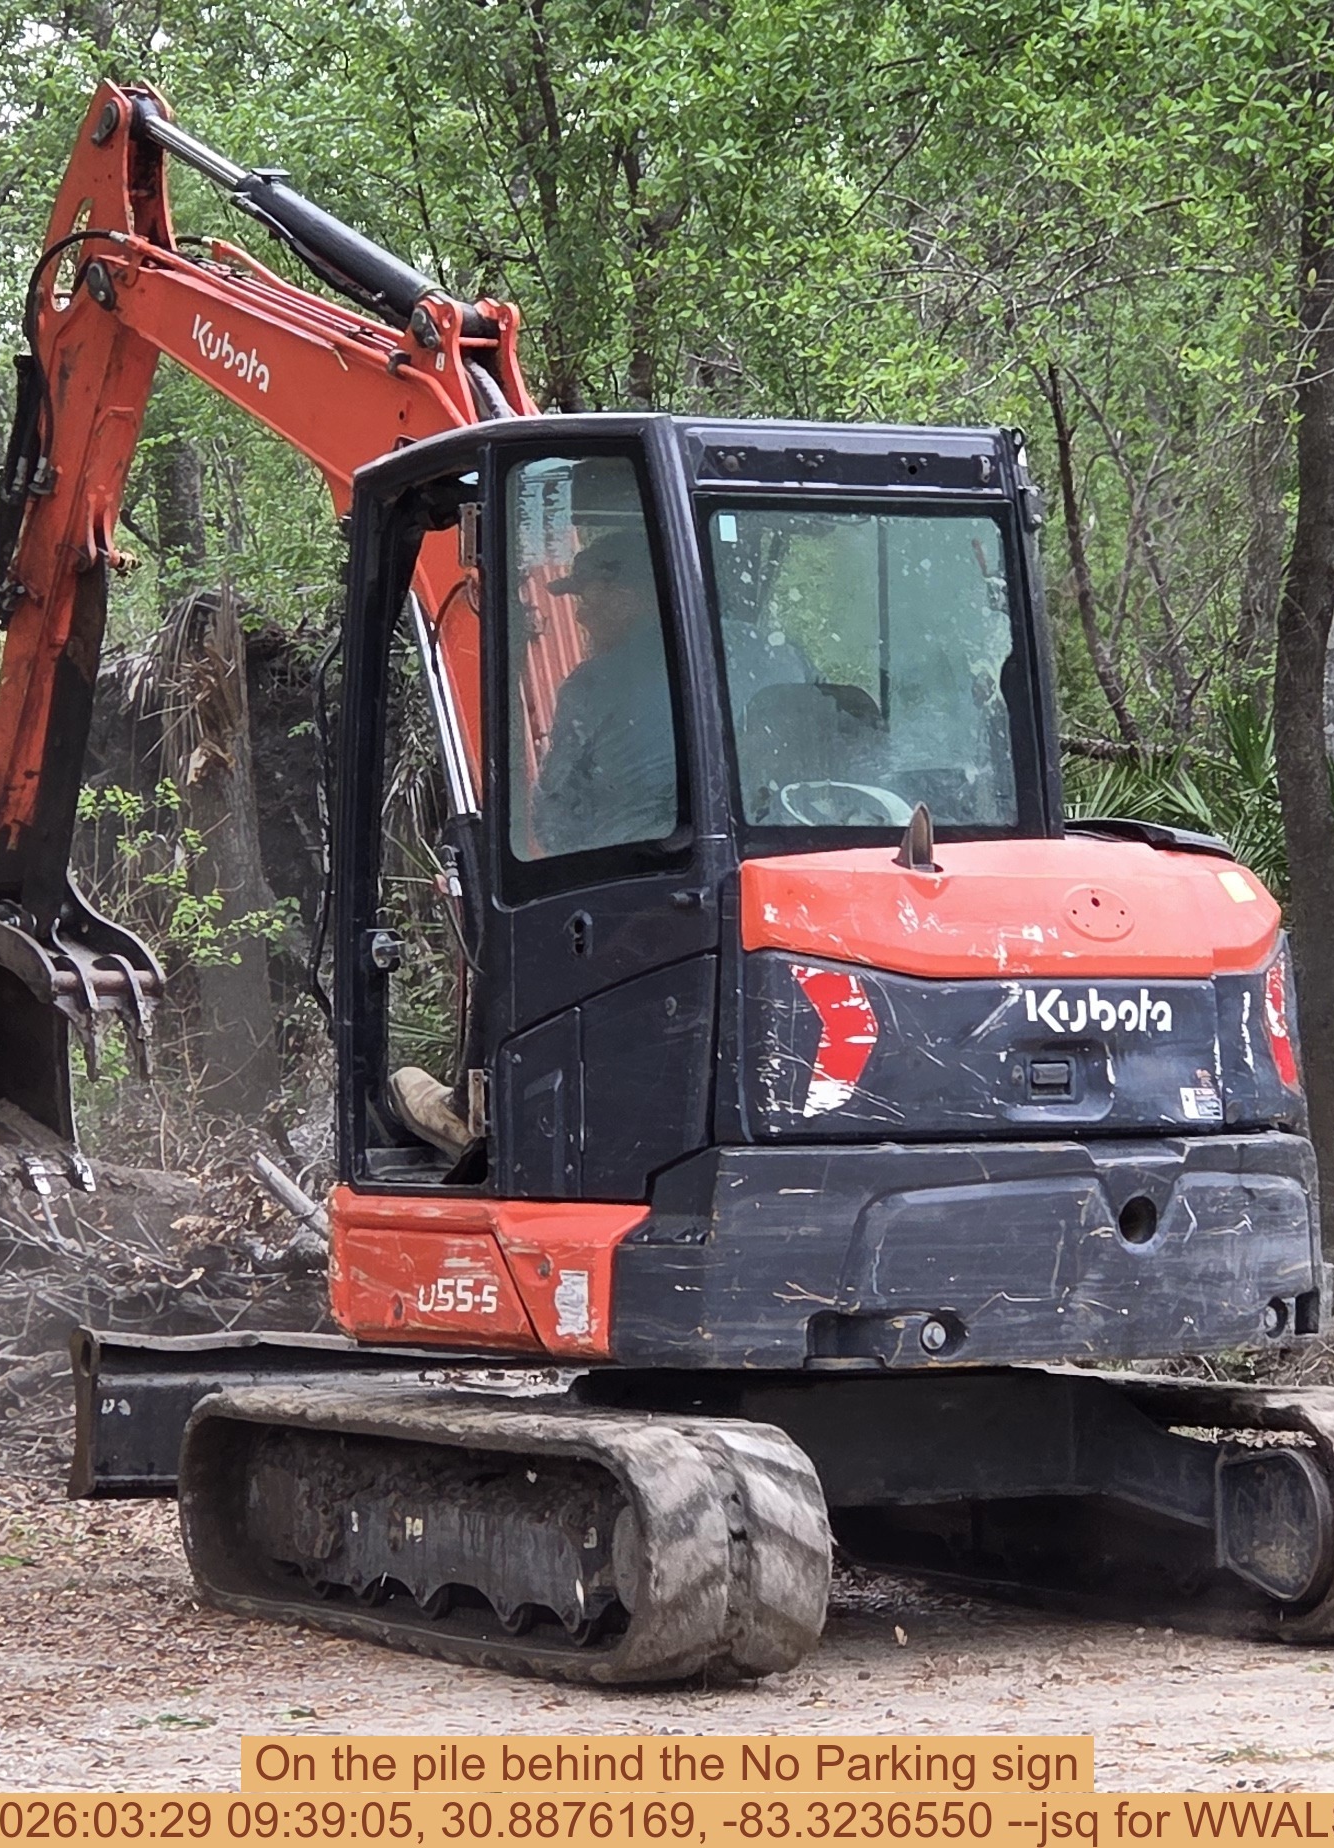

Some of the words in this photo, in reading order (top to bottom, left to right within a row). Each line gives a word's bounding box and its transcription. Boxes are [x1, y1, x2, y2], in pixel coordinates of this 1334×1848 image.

[191, 313, 270, 393] Kubota
[1025, 988, 1172, 1032] Kubota
[418, 1278, 498, 1314] U55-5
